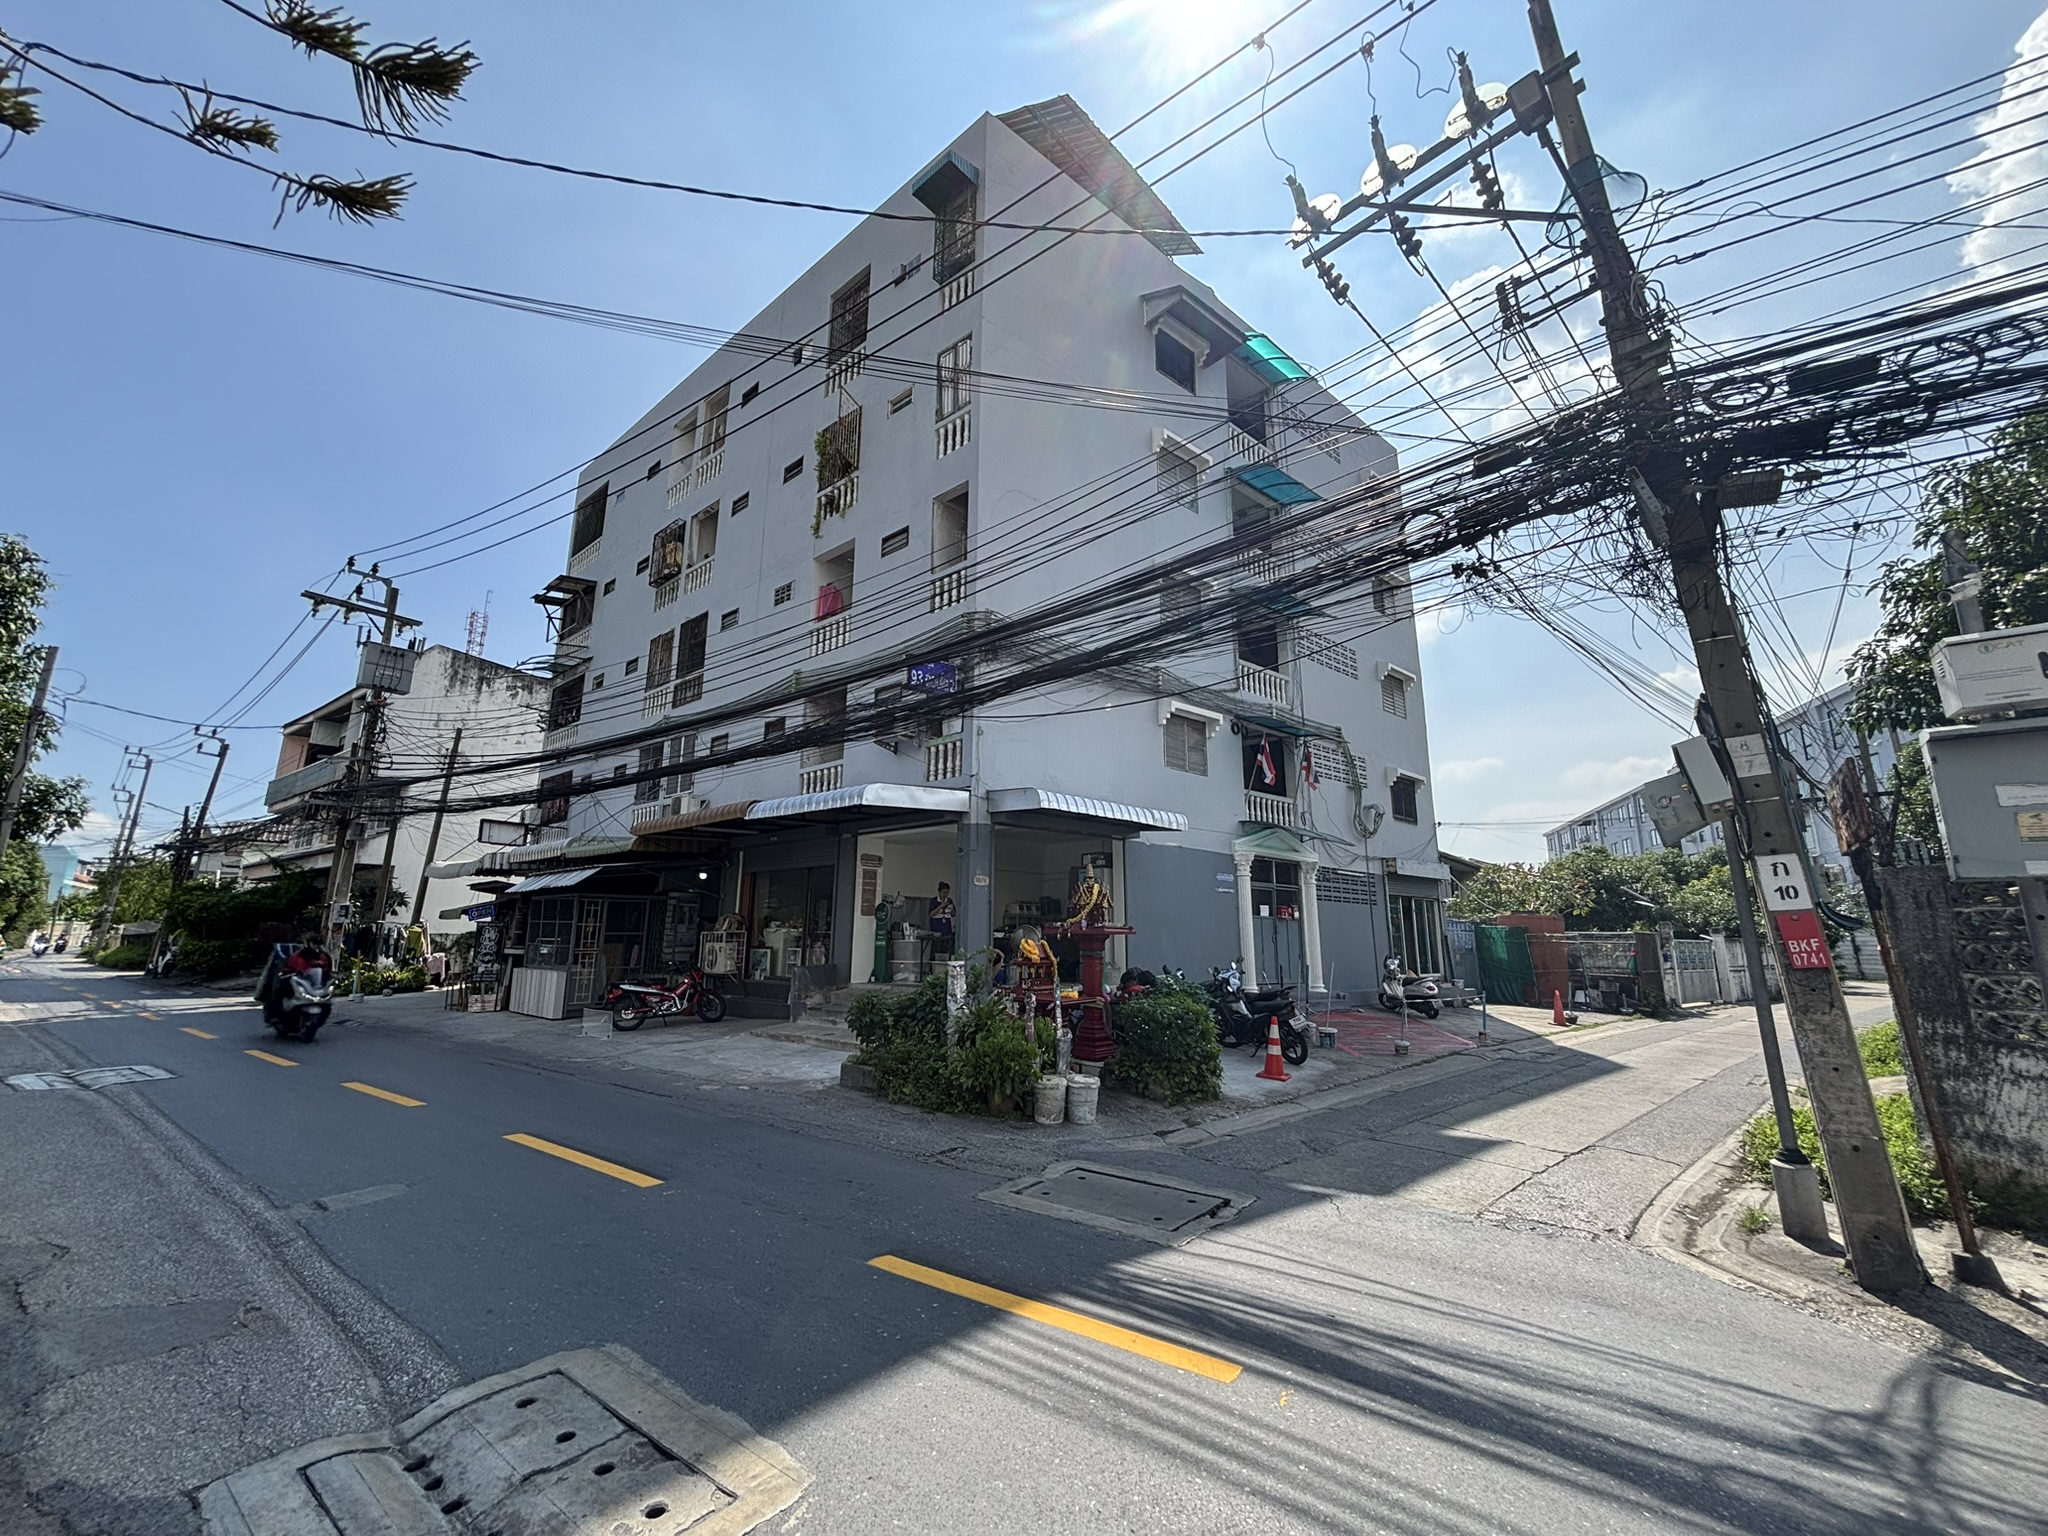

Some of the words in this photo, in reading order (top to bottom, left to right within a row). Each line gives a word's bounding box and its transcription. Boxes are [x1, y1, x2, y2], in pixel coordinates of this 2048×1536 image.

[1744, 760, 1754, 773] 7
[1774, 885, 1799, 901] 10
[1788, 938, 1820, 953] BKF
[1792, 952, 1827, 966] 0741
